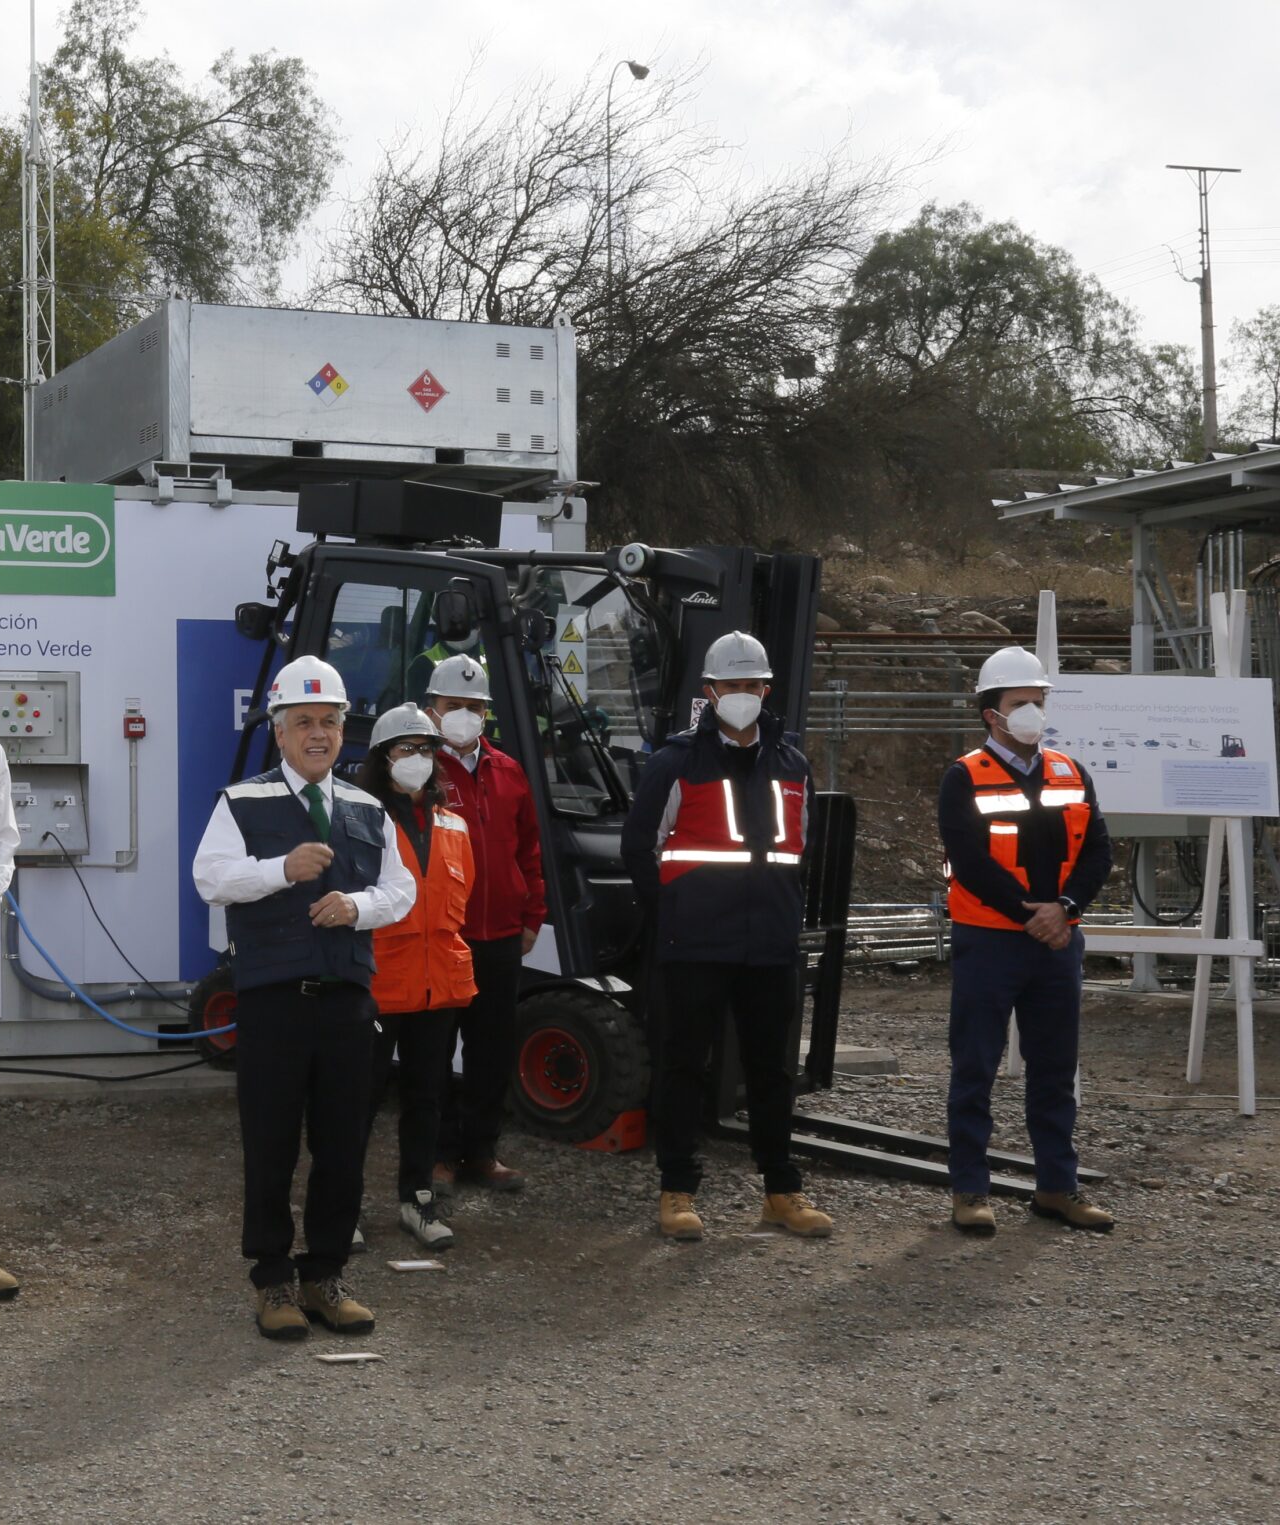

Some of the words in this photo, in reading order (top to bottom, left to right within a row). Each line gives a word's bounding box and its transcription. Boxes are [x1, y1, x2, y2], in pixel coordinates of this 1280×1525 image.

[681, 591, 718, 605] Linde
[37, 640, 92, 657] Verde
[29, 796, 35, 805] 2
